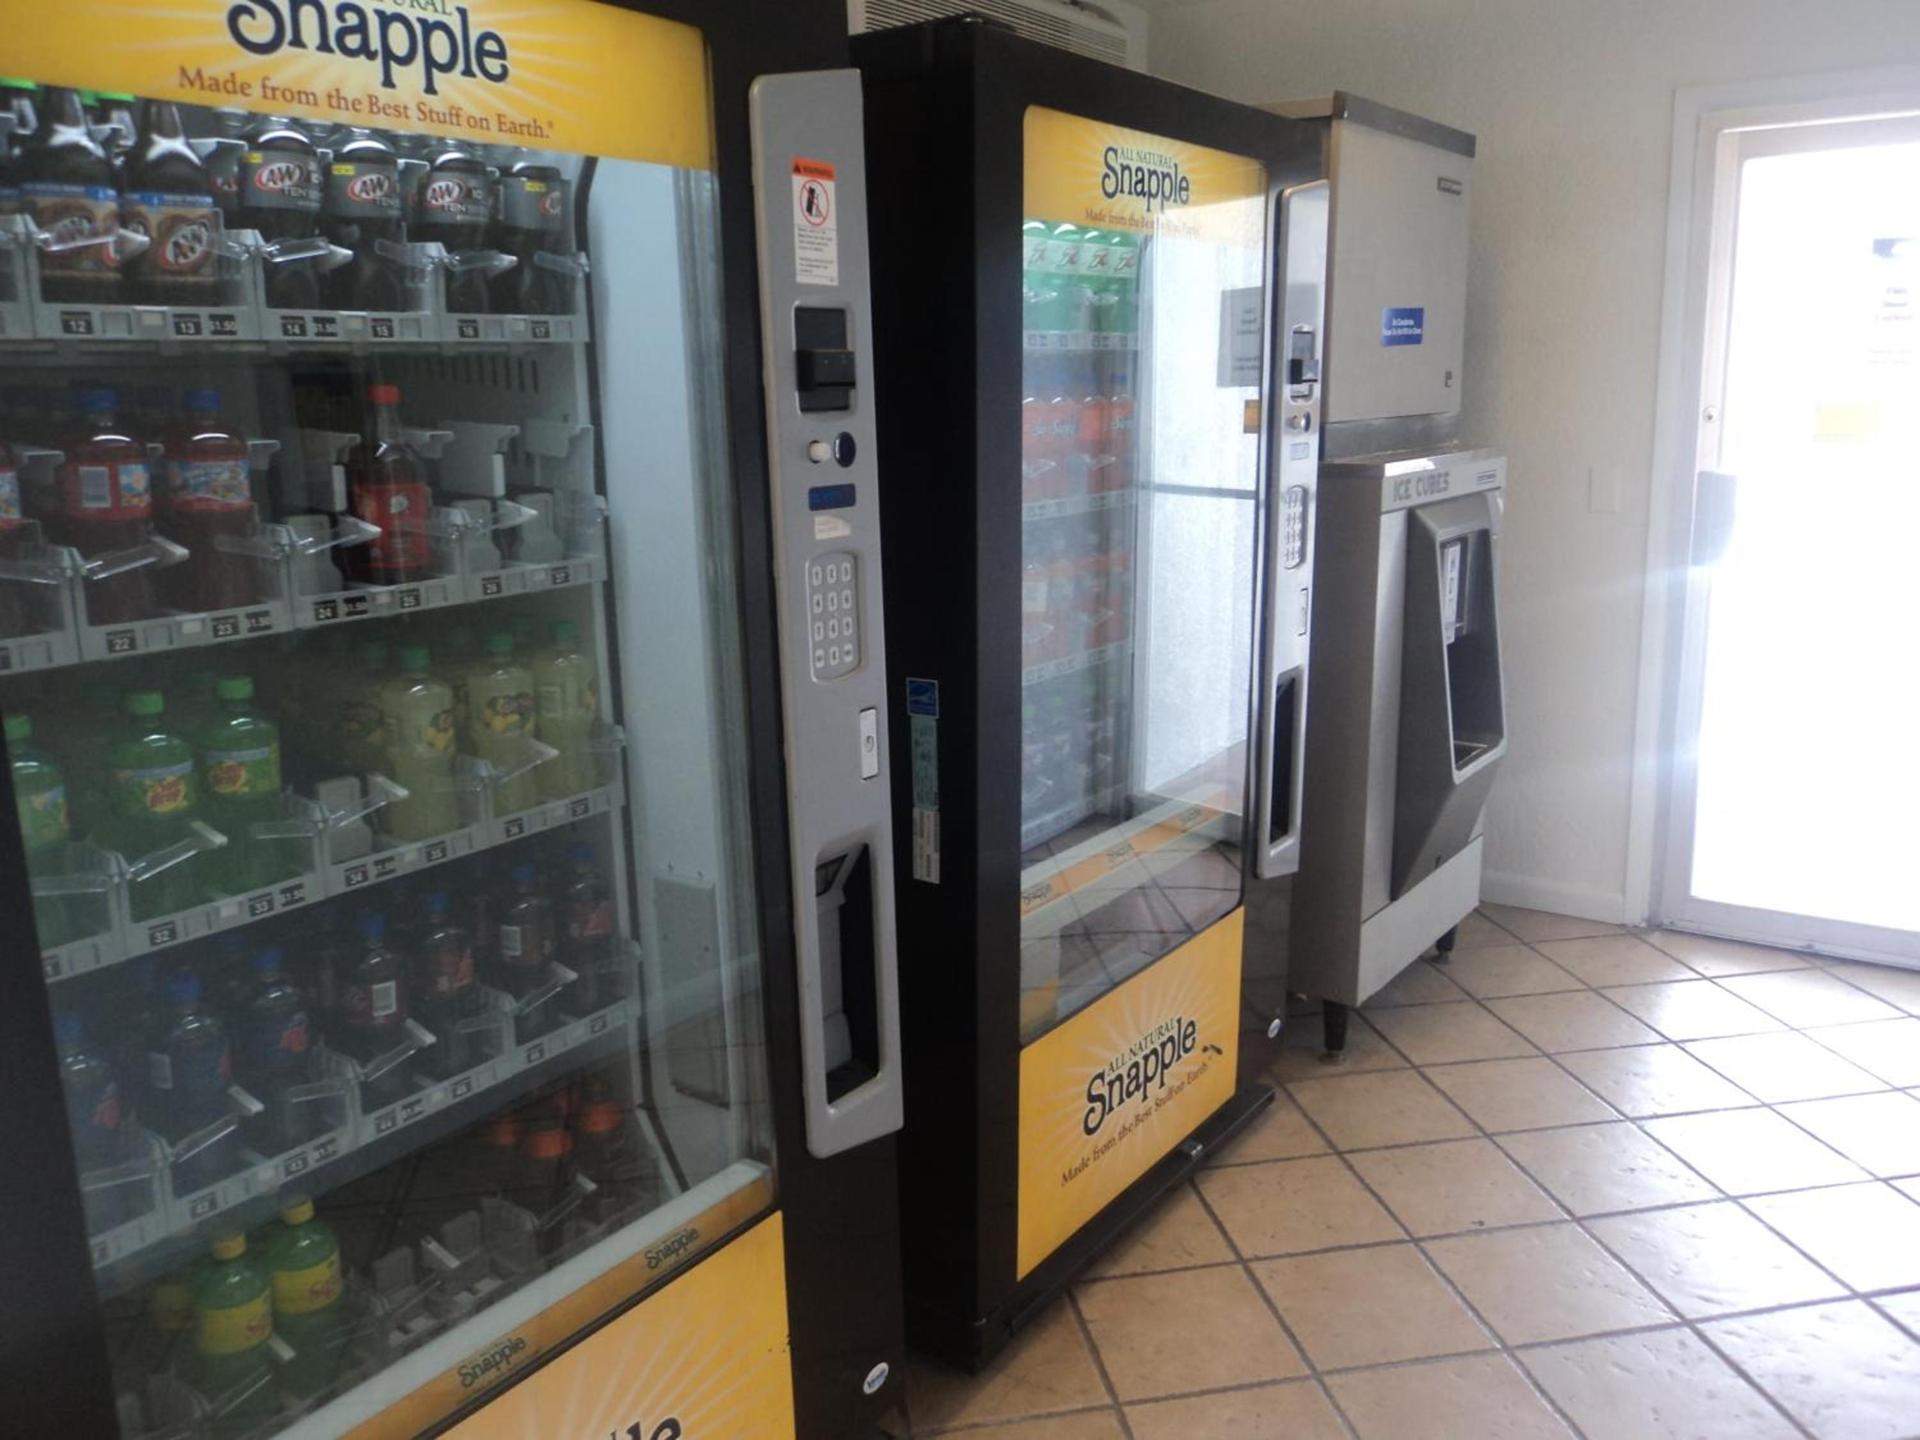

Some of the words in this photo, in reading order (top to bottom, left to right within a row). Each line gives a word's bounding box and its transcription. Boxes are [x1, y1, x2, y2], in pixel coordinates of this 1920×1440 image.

[178, 65, 252, 97] Made
[261, 76, 319, 107] from
[326, 87, 362, 113] the
[367, 94, 410, 119] Best
[416, 101, 464, 127] Stuff
[467, 115, 490, 130] on
[1102, 146, 1190, 214] Snapple
[69, 321, 86, 332] 12
[180, 322, 195, 334] 13
[1392, 478, 1412, 502] ICE
[1416, 470, 1450, 497] CUBES
[1128, 1017, 1176, 1061] NATURAL
[1083, 1016, 1197, 1136] Snapple
[1061, 1154, 1090, 1186] Made
[1092, 1135, 1117, 1164] from
[1117, 1119, 1134, 1142] the
[1134, 1105, 1153, 1129] Best
[644, 1227, 699, 1270] Snapple
[457, 1336, 526, 1388] Snapple
